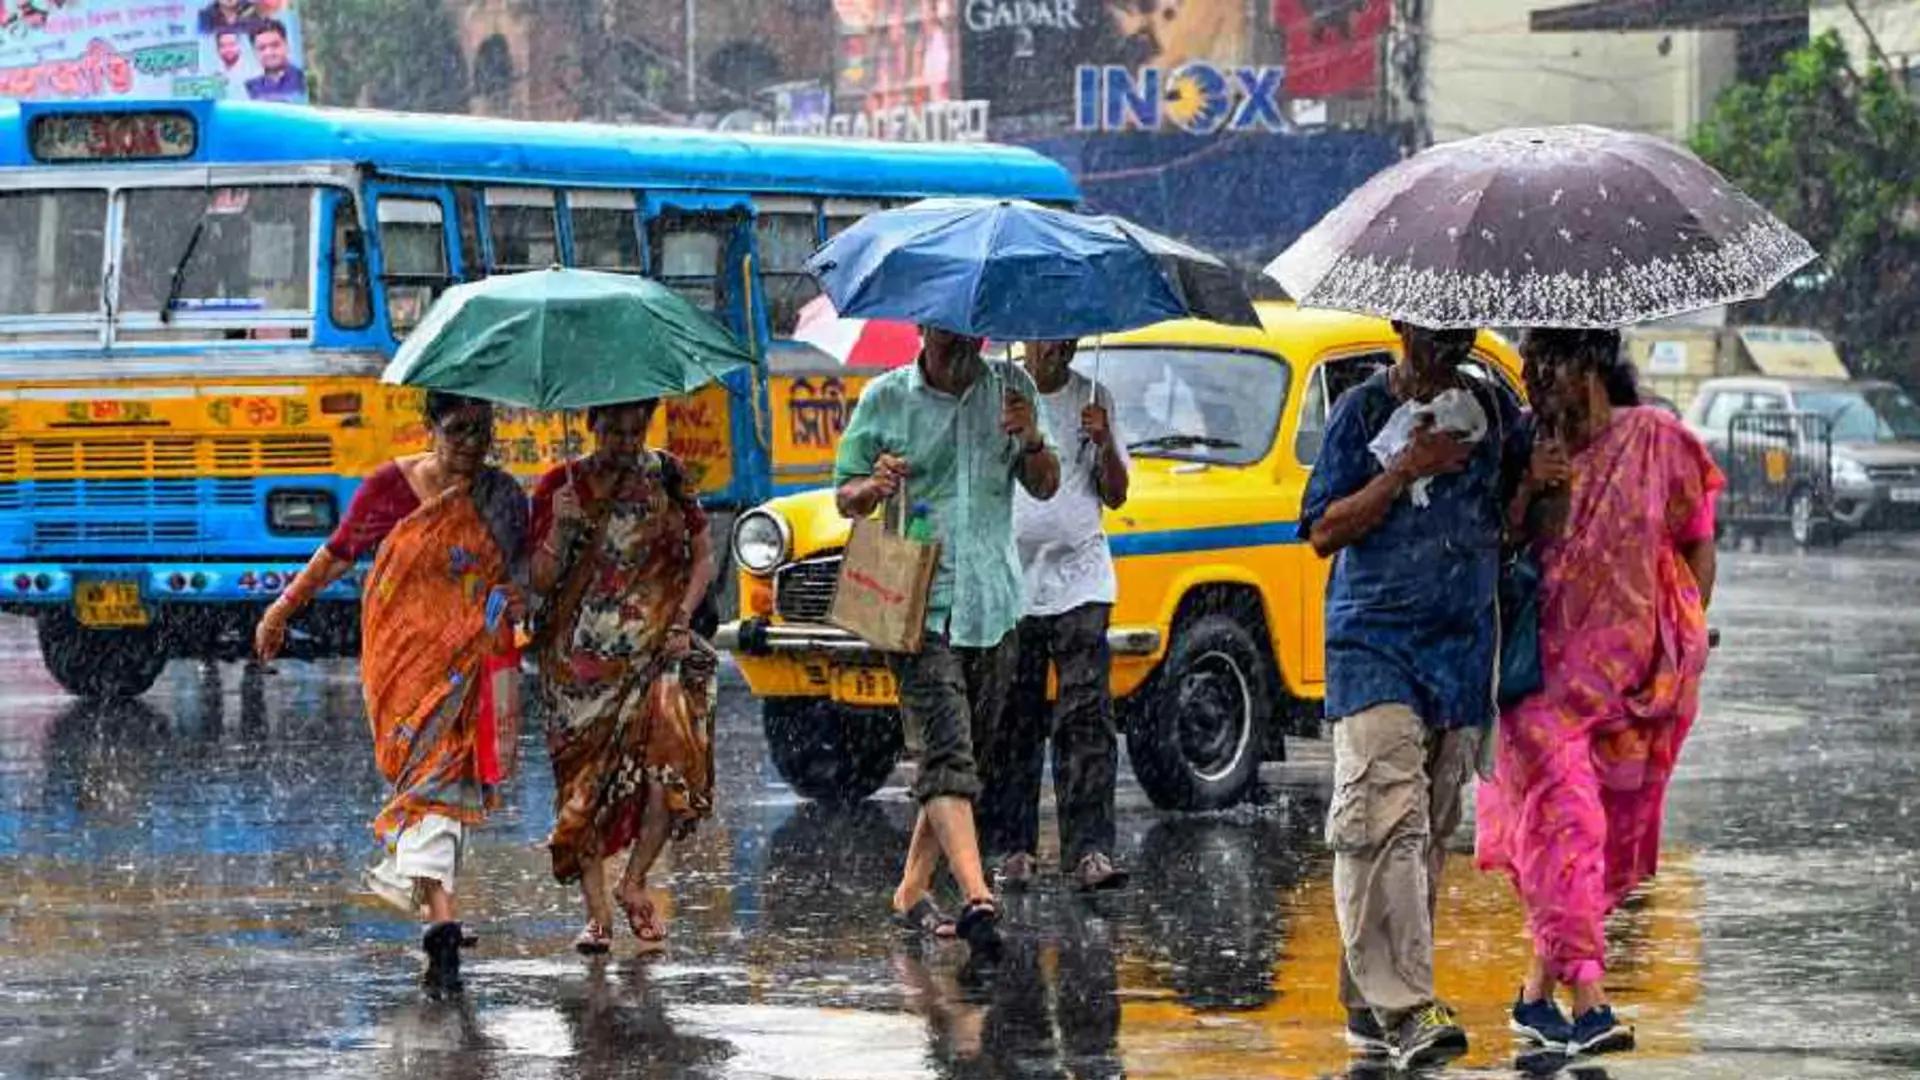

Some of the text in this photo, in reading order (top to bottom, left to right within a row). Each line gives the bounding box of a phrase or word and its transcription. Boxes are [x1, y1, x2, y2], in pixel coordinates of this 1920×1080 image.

[965, 0, 1082, 31] GADAR
[1013, 27, 1035, 57] 2
[1075, 61, 1288, 135] INOX
